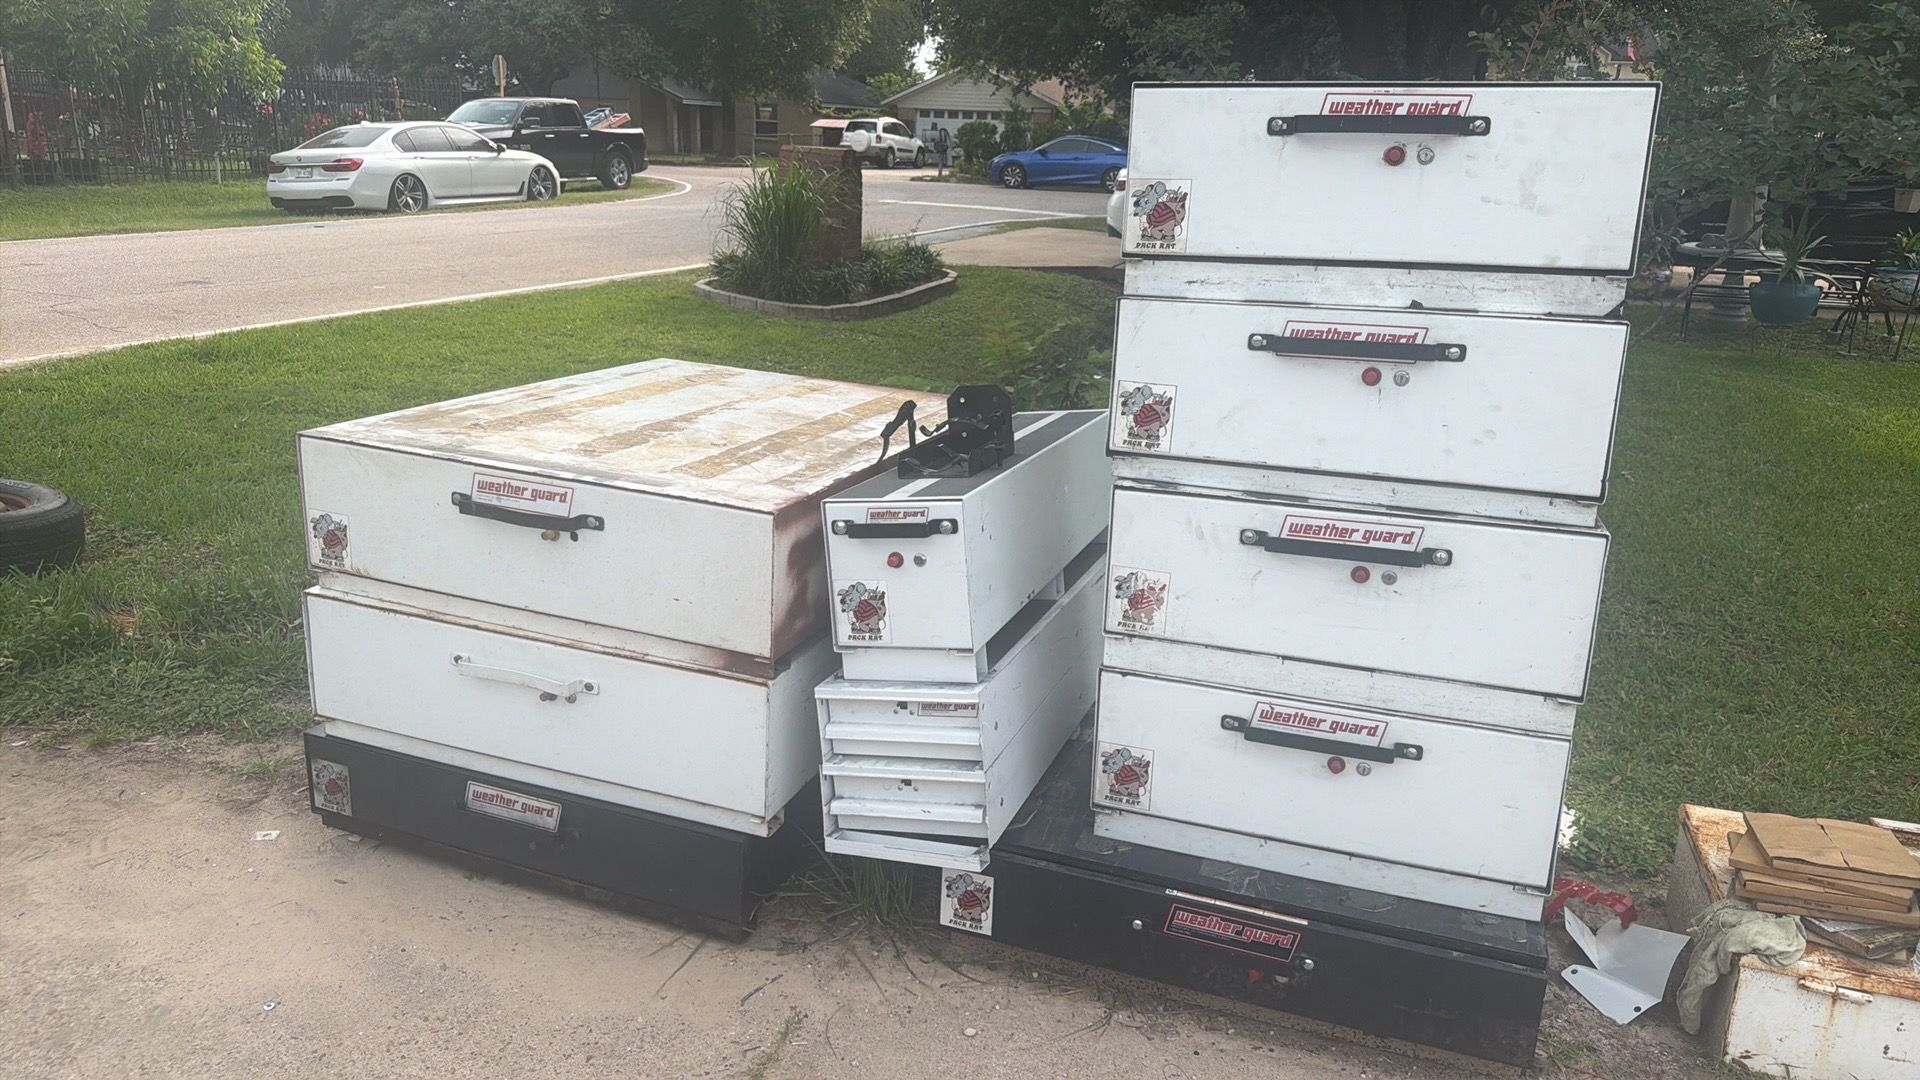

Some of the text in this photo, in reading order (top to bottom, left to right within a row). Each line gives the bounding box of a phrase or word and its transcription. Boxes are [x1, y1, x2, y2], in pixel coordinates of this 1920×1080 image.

[1328, 99, 1462, 117] weather guard
[1135, 241, 1177, 250] PACK RAT
[1289, 327, 1363, 341] weather
[1122, 439, 1143, 447] PACK
[477, 479, 529, 497] weather
[530, 488, 568, 504] guard
[869, 509, 926, 519] weather guard
[1288, 521, 1416, 545] weather guard
[921, 701, 977, 711] weather guard
[1259, 708, 1328, 728] weather
[1329, 719, 1380, 737] guard
[472, 789, 519, 808] weather
[520, 801, 555, 818] guard
[1104, 794, 1141, 806] PACK RAT
[948, 918, 984, 931] PACK RAT
[1174, 910, 1242, 935] weather
[1241, 926, 1294, 949] guard
